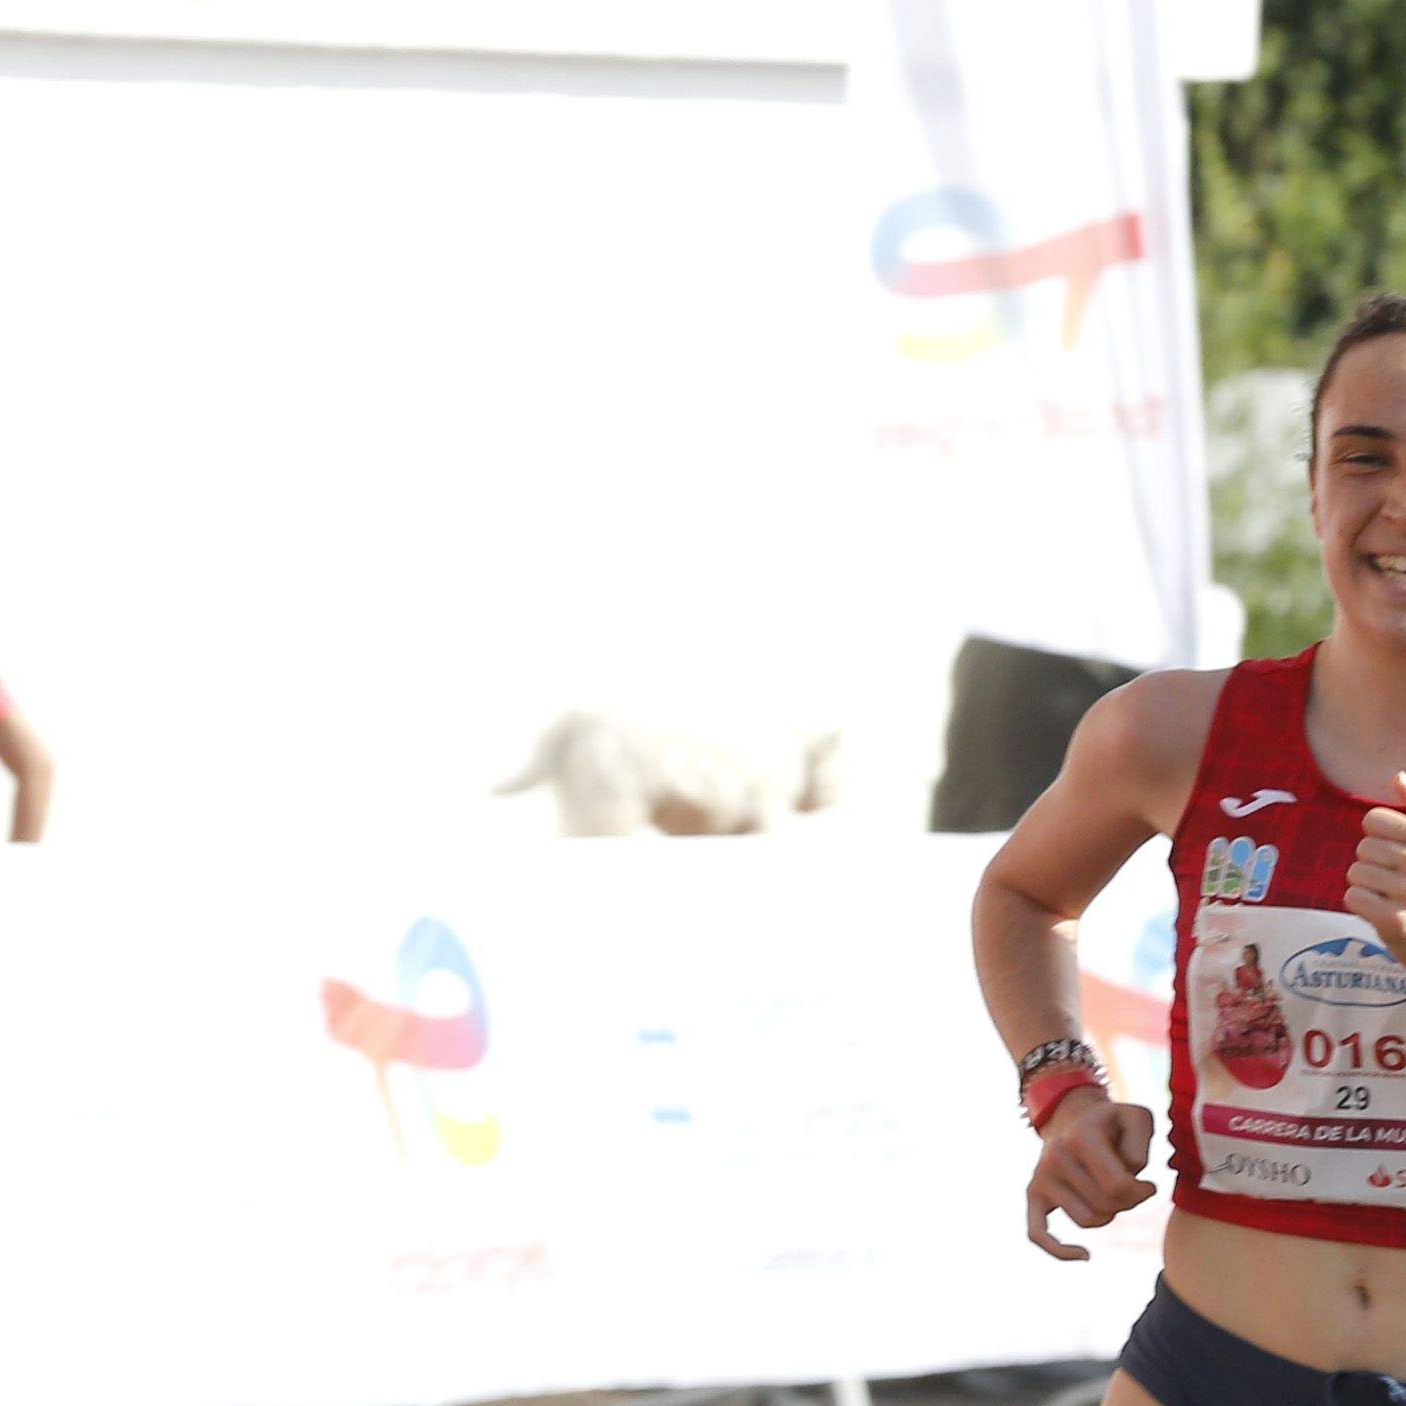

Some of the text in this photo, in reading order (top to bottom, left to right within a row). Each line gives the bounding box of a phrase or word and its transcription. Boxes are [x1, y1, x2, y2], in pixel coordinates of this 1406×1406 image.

[1335, 1085, 1371, 1111] 29
[1228, 1115, 1312, 1140] CARRERA
[1313, 1125, 1344, 1142] DE
[1345, 1126, 1372, 1142] LA
[1225, 1152, 1312, 1186] OYSHO
